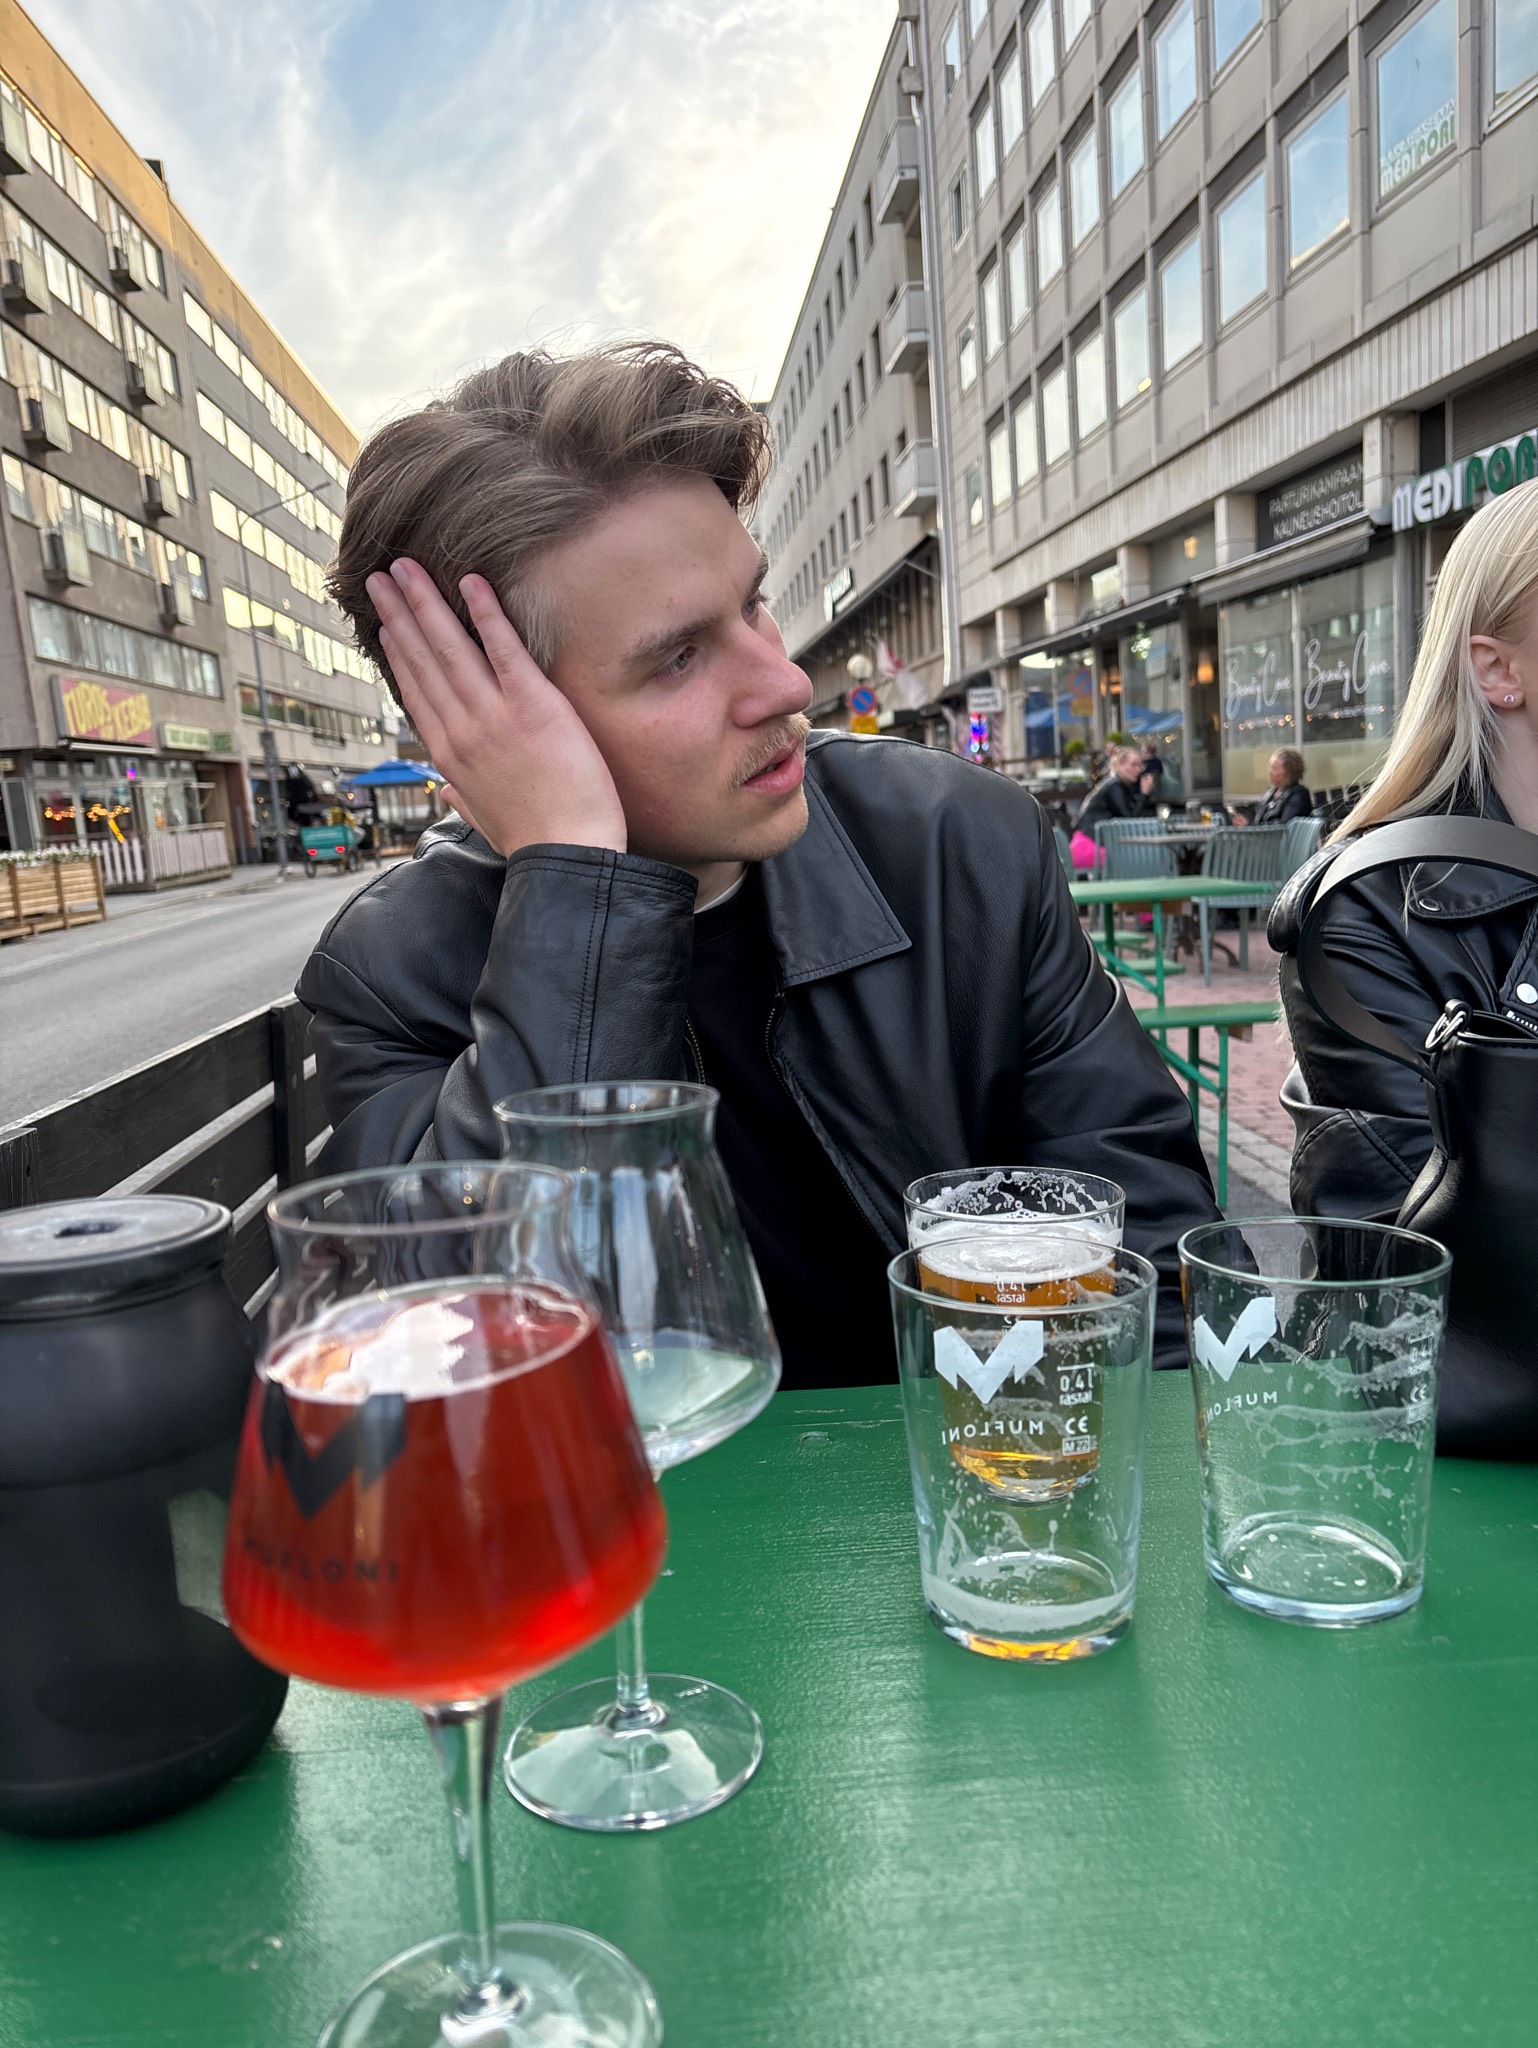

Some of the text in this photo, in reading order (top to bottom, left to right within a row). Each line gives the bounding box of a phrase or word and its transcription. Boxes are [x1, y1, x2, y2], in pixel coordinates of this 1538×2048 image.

[1381, 113, 1455, 197] MEDIPORI
[1392, 435, 1538, 533] MEDIPOR
[1272, 488, 1364, 541] KAUNEUSHOITOL
[1226, 657, 1262, 720] Beauty
[1304, 638, 1350, 710] Beauty
[995, 1293, 1026, 1304] rastal
[1059, 1390, 1093, 1406] rastal
[1065, 1415, 1089, 1435] CE
